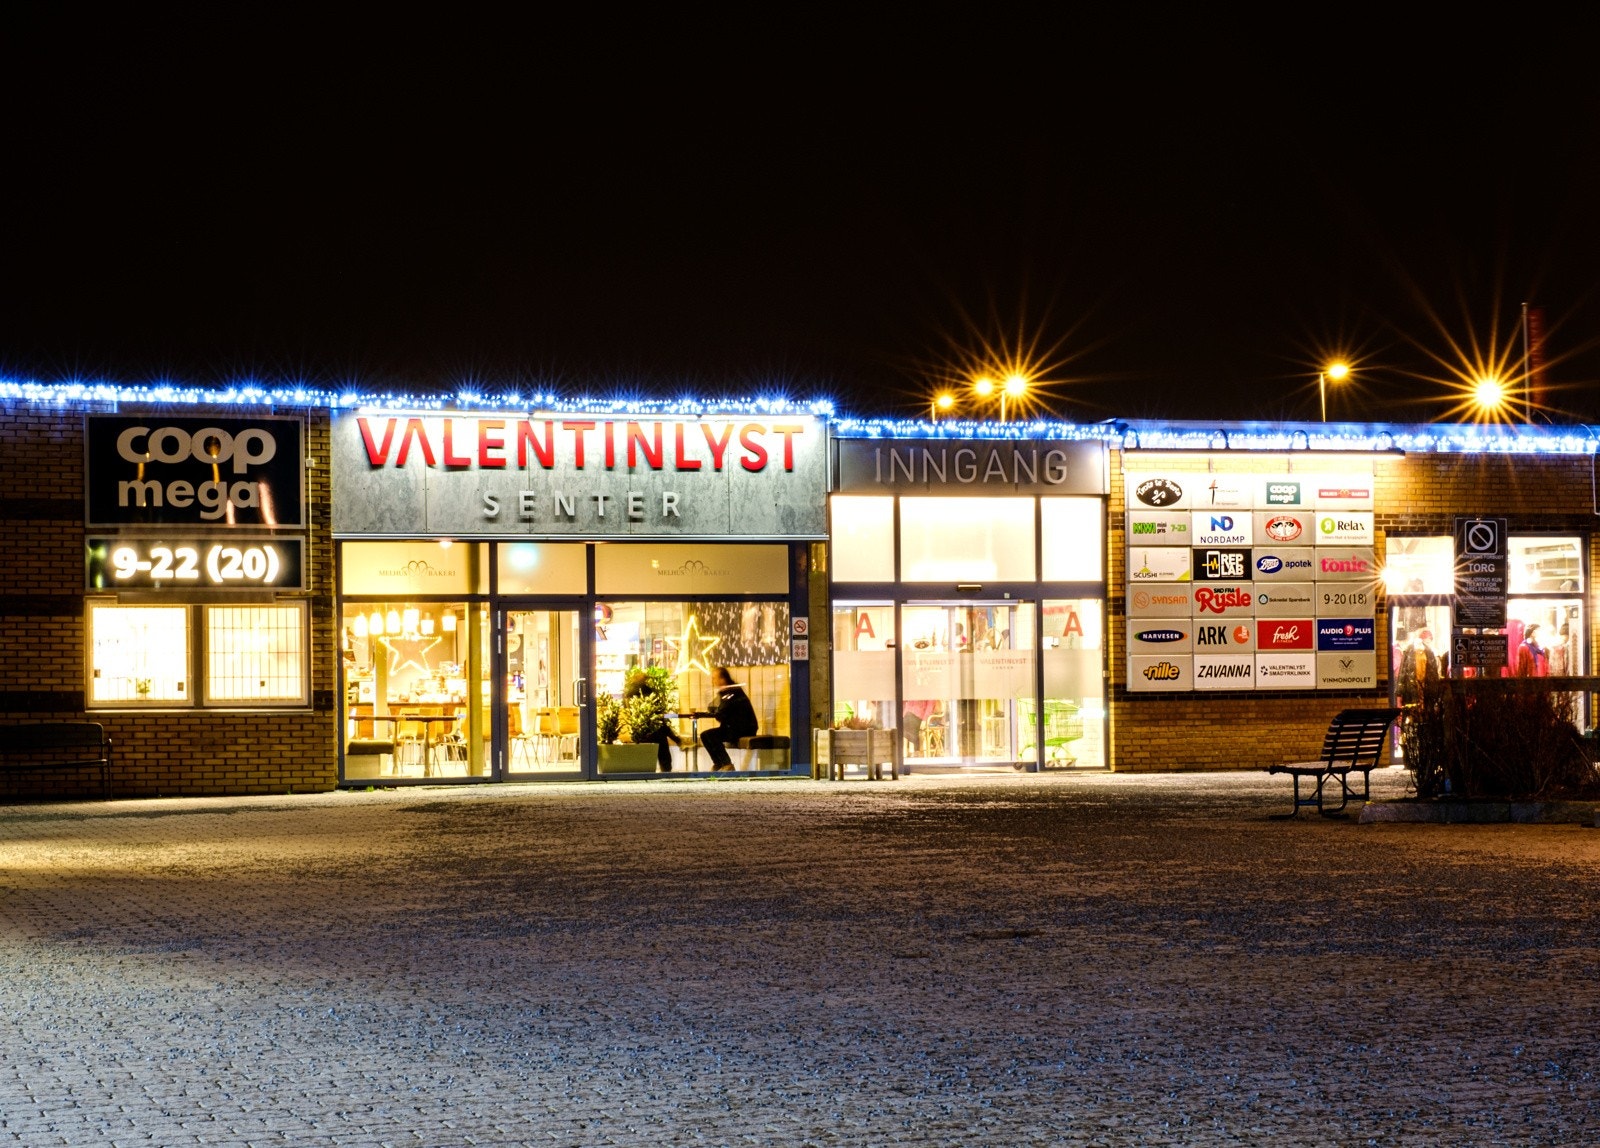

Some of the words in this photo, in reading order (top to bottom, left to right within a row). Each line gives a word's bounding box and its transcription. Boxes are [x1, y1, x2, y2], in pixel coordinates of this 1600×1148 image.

[116, 426, 277, 474] coop
[357, 417, 804, 472] VALENTINLYST
[875, 447, 1068, 484] INNGANG
[118, 479, 260, 520] mega
[483, 490, 681, 518] SENTER
[1133, 522, 1156, 534] KIWI
[1337, 520, 1365, 531] Relax
[113, 548, 199, 579] 9-22
[207, 545, 279, 583] (20)
[1220, 553, 1244, 564] REP
[1285, 560, 1312, 569] apotek
[1321, 556, 1367, 573] tonic
[1220, 564, 1244, 575] LAB
[1468, 564, 1495, 573] TORG
[1349, 594, 1367, 605] (18)
[854, 612, 876, 638] A
[1063, 612, 1084, 637] A
[1197, 626, 1227, 645] ARK
[1272, 625, 1299, 643] fresh
[1197, 665, 1251, 678] ZAVANNA
